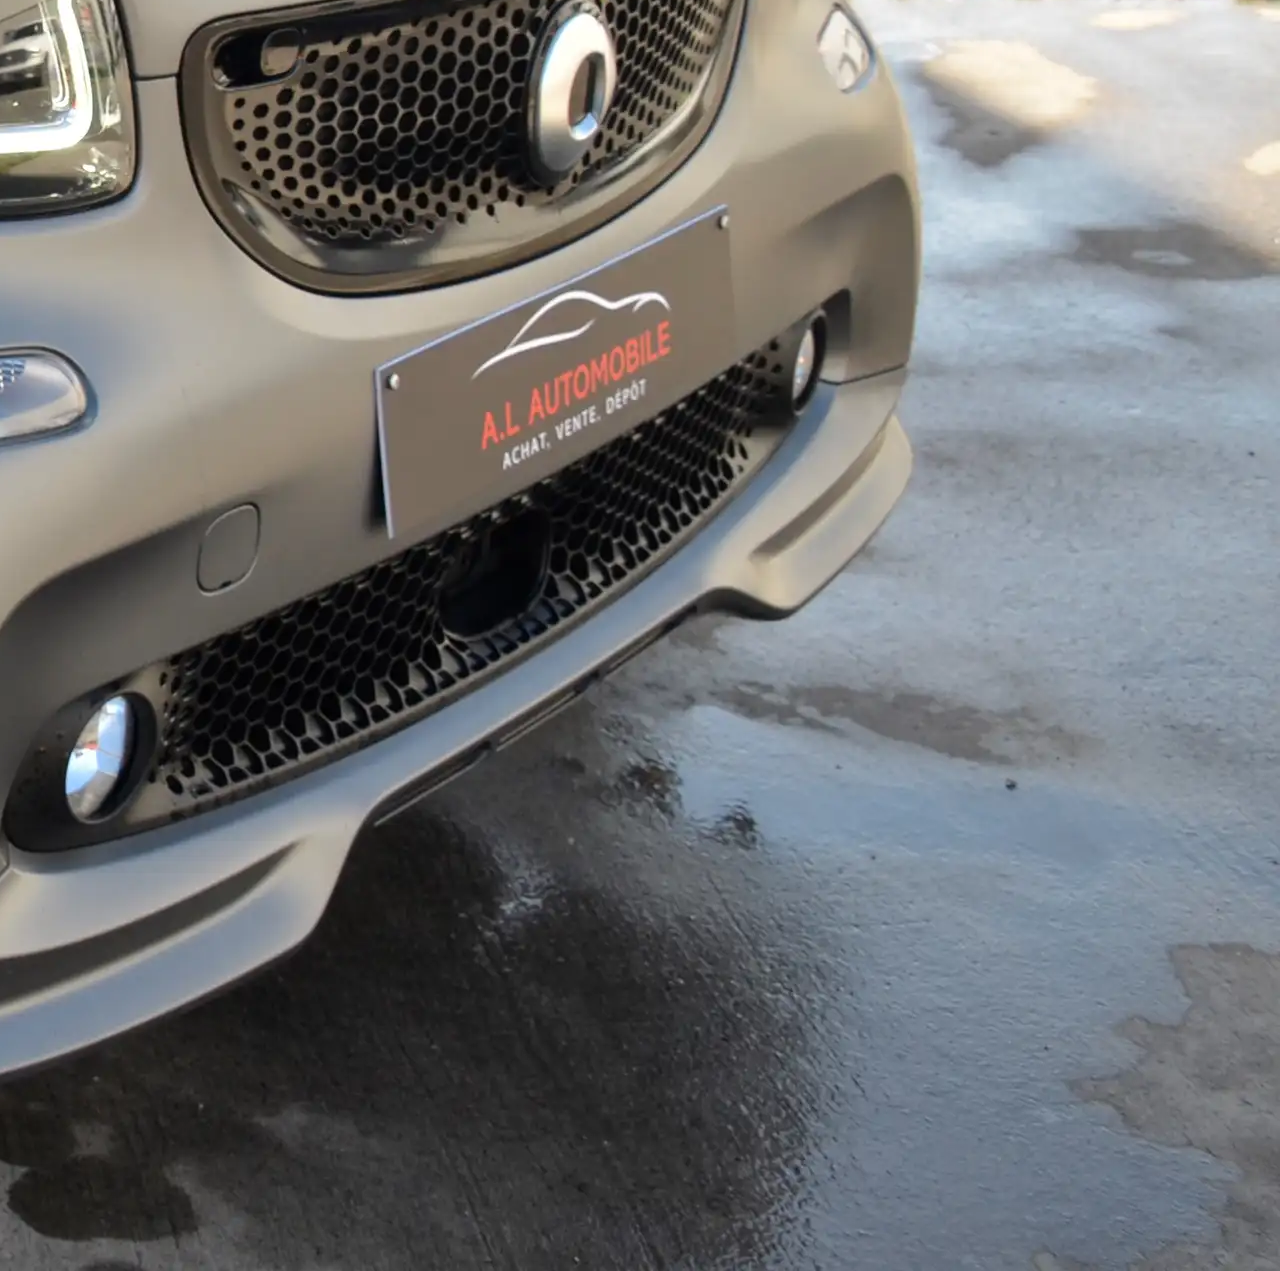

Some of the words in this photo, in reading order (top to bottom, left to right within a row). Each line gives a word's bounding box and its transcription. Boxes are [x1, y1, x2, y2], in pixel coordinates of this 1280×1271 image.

[481, 400, 521, 450] A.L
[528, 320, 672, 425] AUTOMOBILE
[606, 378, 647, 414] DÉPÔT
